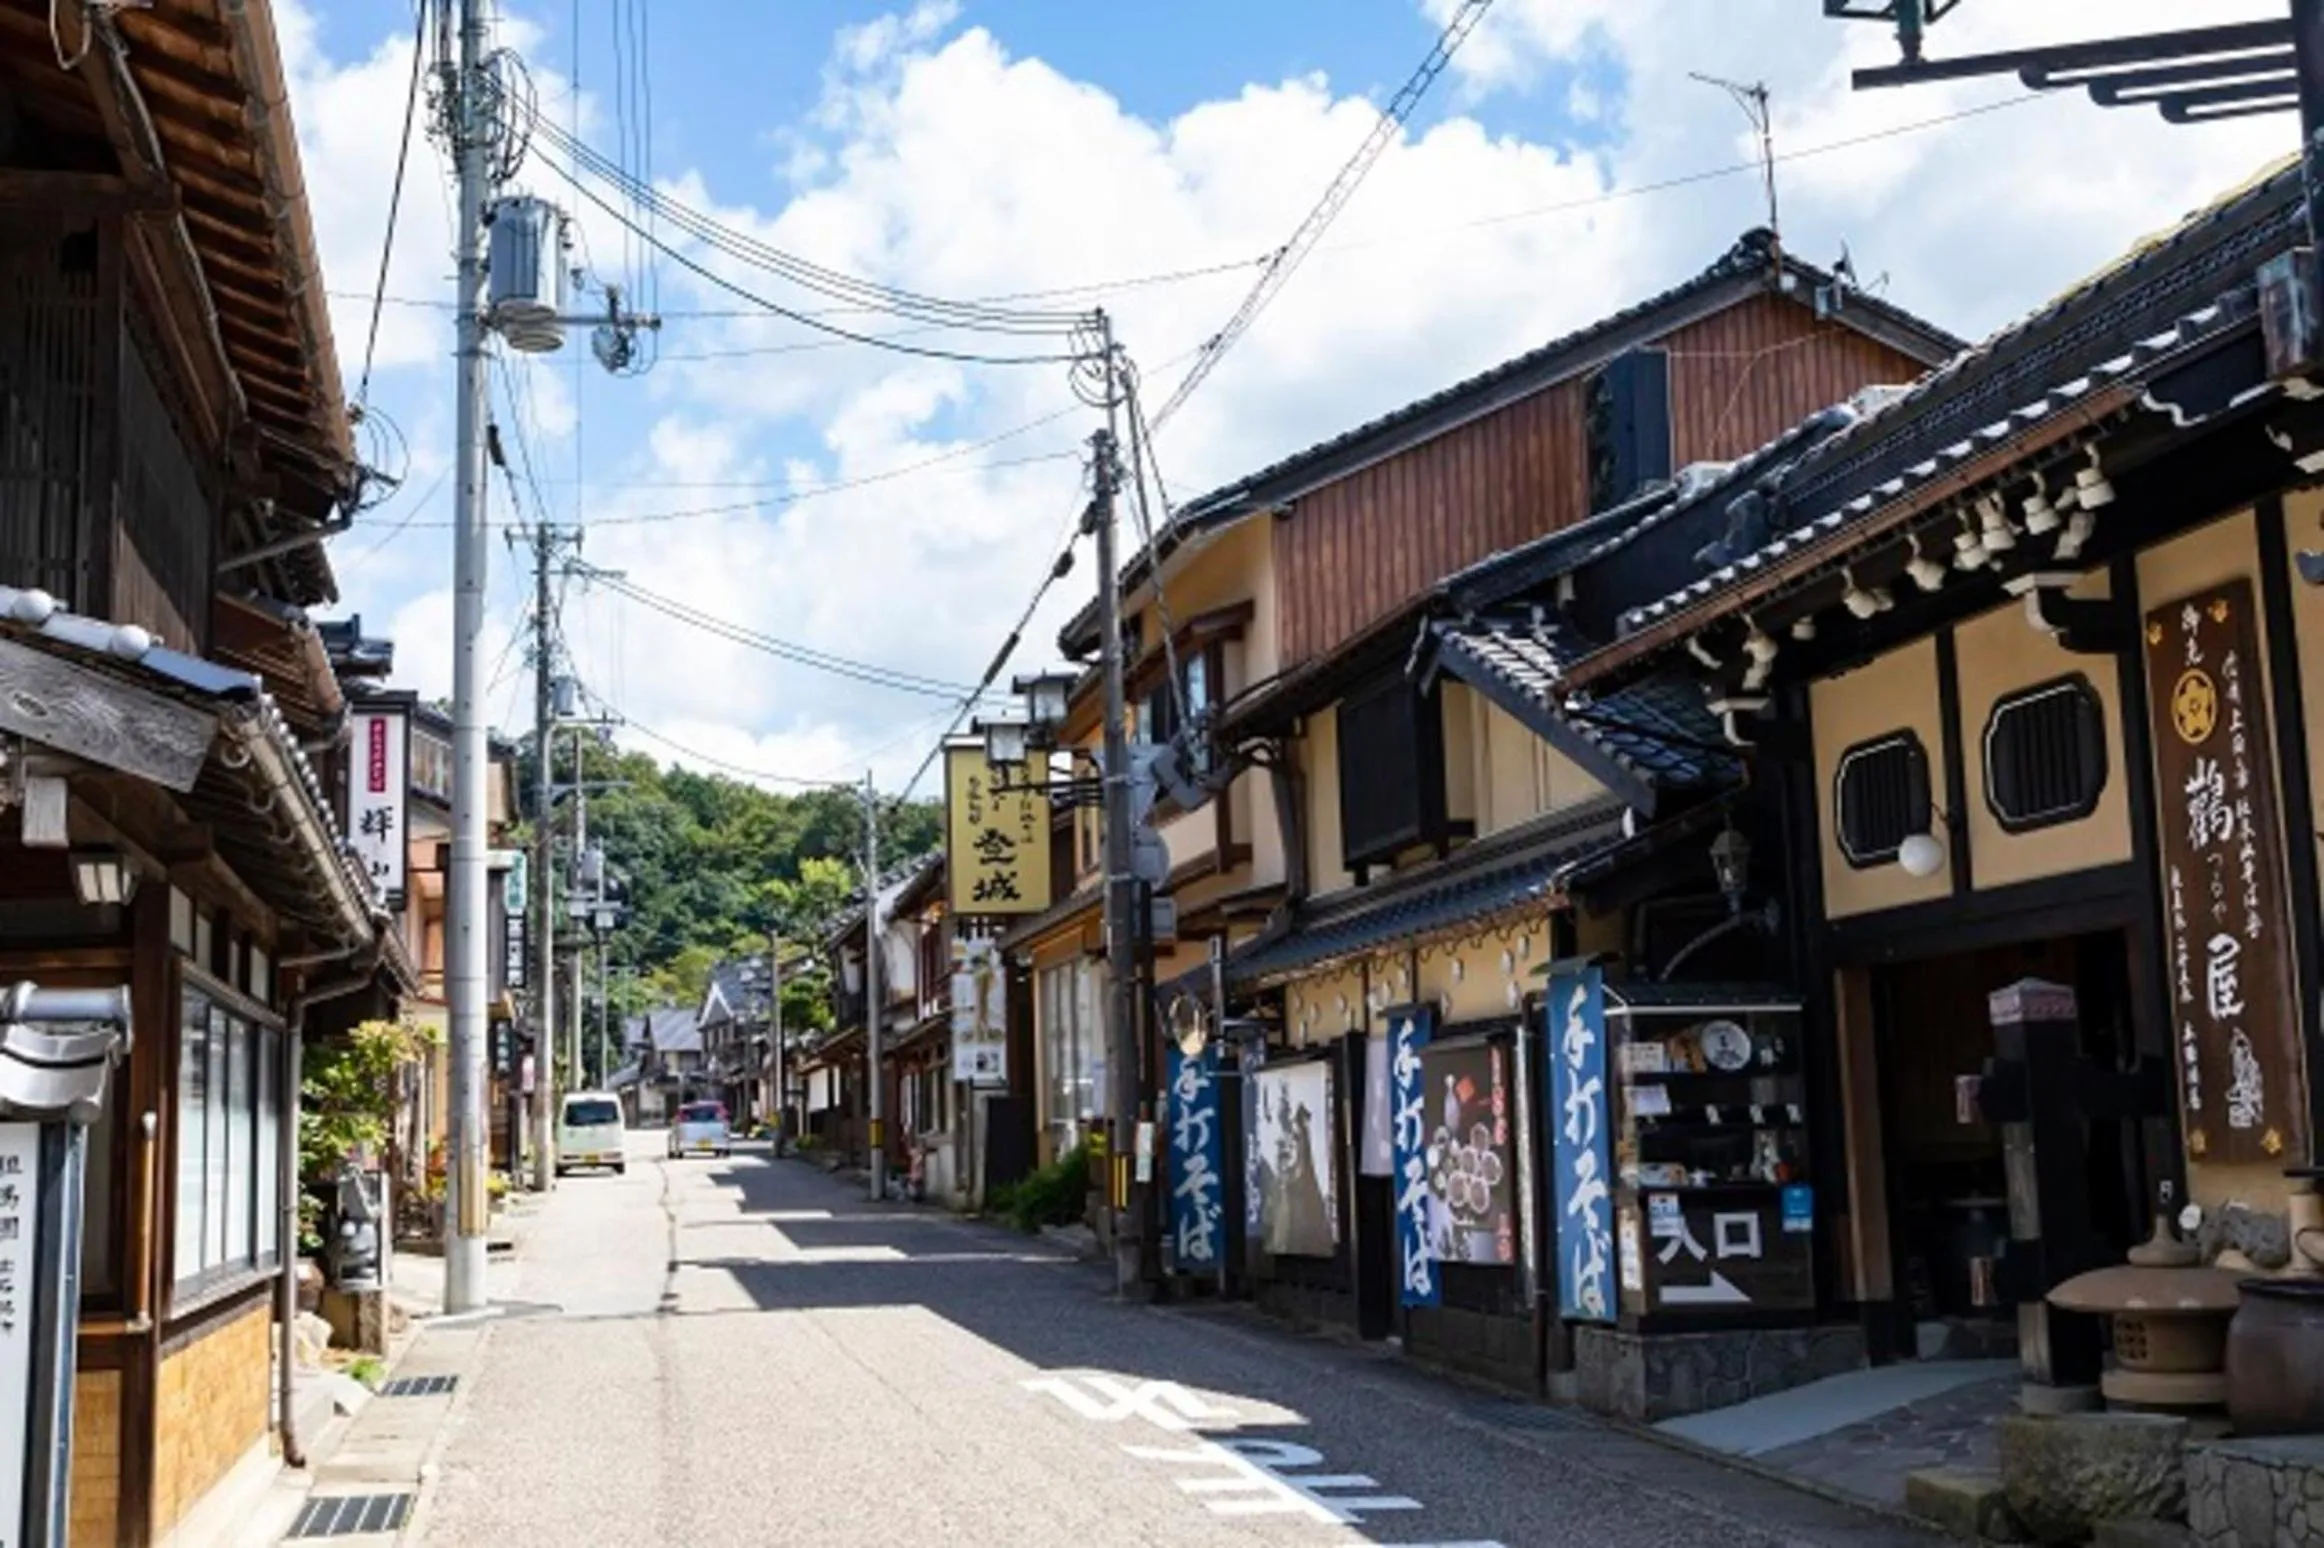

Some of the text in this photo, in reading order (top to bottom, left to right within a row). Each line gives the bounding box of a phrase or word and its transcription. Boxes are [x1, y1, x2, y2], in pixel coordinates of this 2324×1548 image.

[1563, 983, 1612, 1318] 手打そば
[1657, 1211, 1763, 1265] 入口
